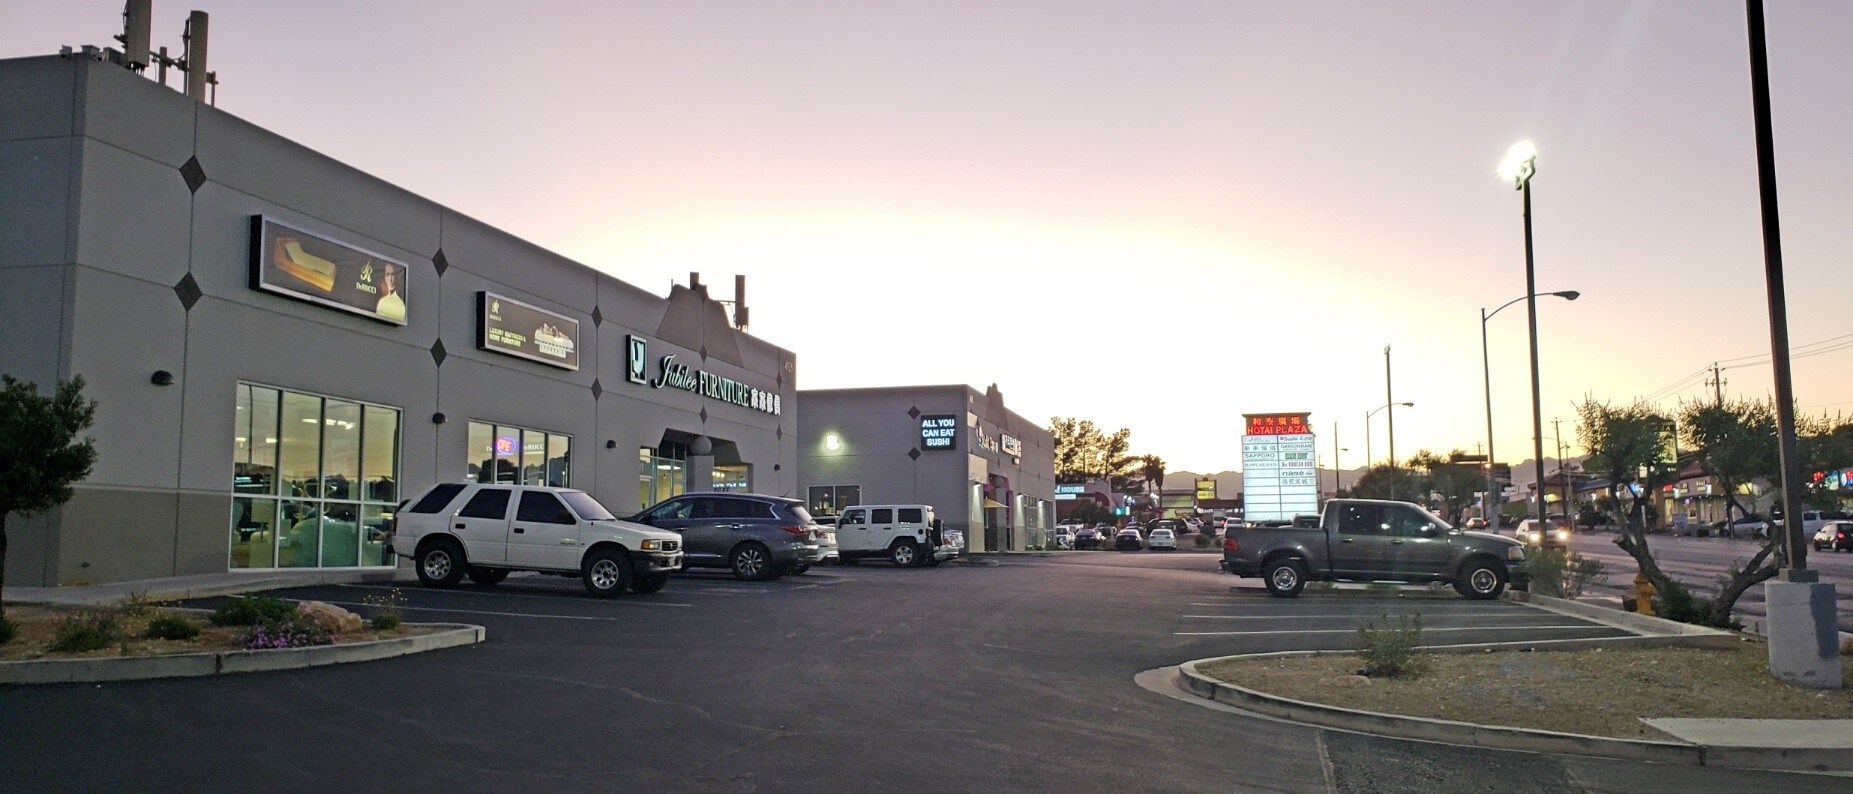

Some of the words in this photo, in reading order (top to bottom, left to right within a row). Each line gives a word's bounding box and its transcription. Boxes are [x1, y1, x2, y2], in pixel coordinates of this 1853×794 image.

[655, 354, 697, 391] Jubilee
[699, 370, 749, 407] FURNITURE
[922, 419, 937, 428] ALL
[938, 419, 955, 427] YOU
[922, 429, 939, 437] CAN
[940, 429, 955, 437] EAT
[926, 438, 950, 446] SUSHI
